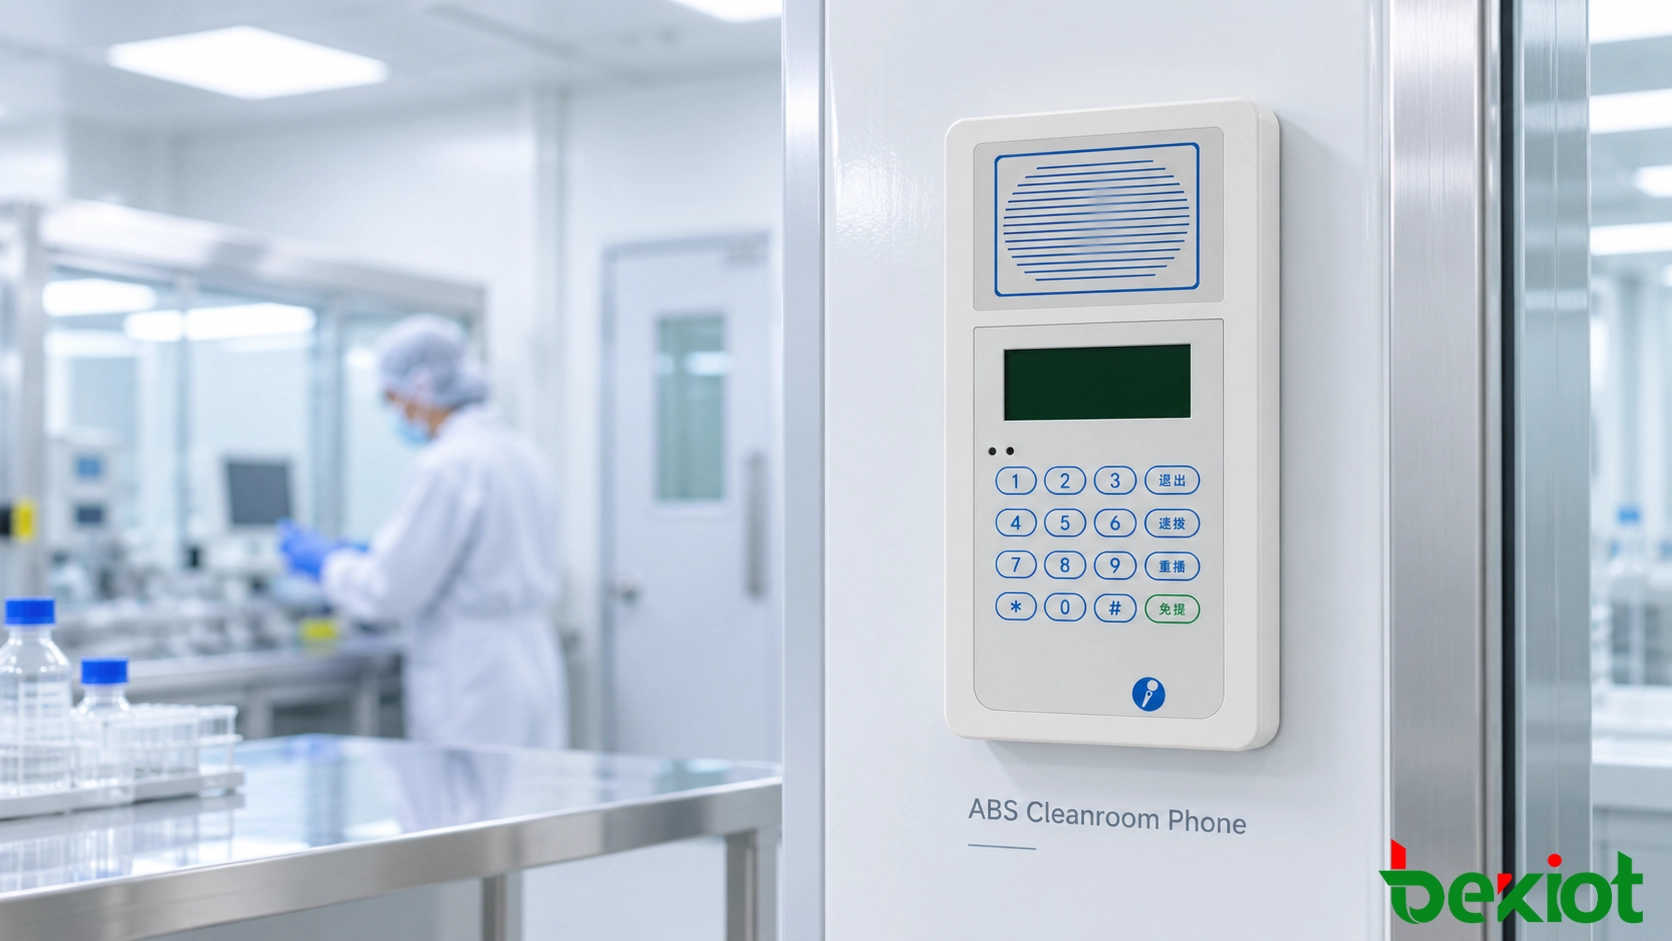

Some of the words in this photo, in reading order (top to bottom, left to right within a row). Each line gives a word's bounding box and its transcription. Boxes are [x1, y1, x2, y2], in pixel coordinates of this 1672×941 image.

[1011, 473, 1019, 489] 1
[1059, 472, 1070, 489] 2
[1110, 472, 1121, 489] 3
[1158, 473, 1187, 487] 退出
[1010, 514, 1021, 531] 4
[1060, 514, 1070, 531] 5
[1110, 515, 1121, 532] 6
[1011, 556, 1021, 573] 7
[1060, 556, 1070, 573] 8
[1110, 557, 1121, 574] 9
[1060, 599, 1070, 615] 0
[1159, 602, 1186, 616] 免提
[968, 797, 1019, 822] ABS
[1026, 801, 1159, 830] Cleanroom
[1168, 809, 1247, 835] Phone
